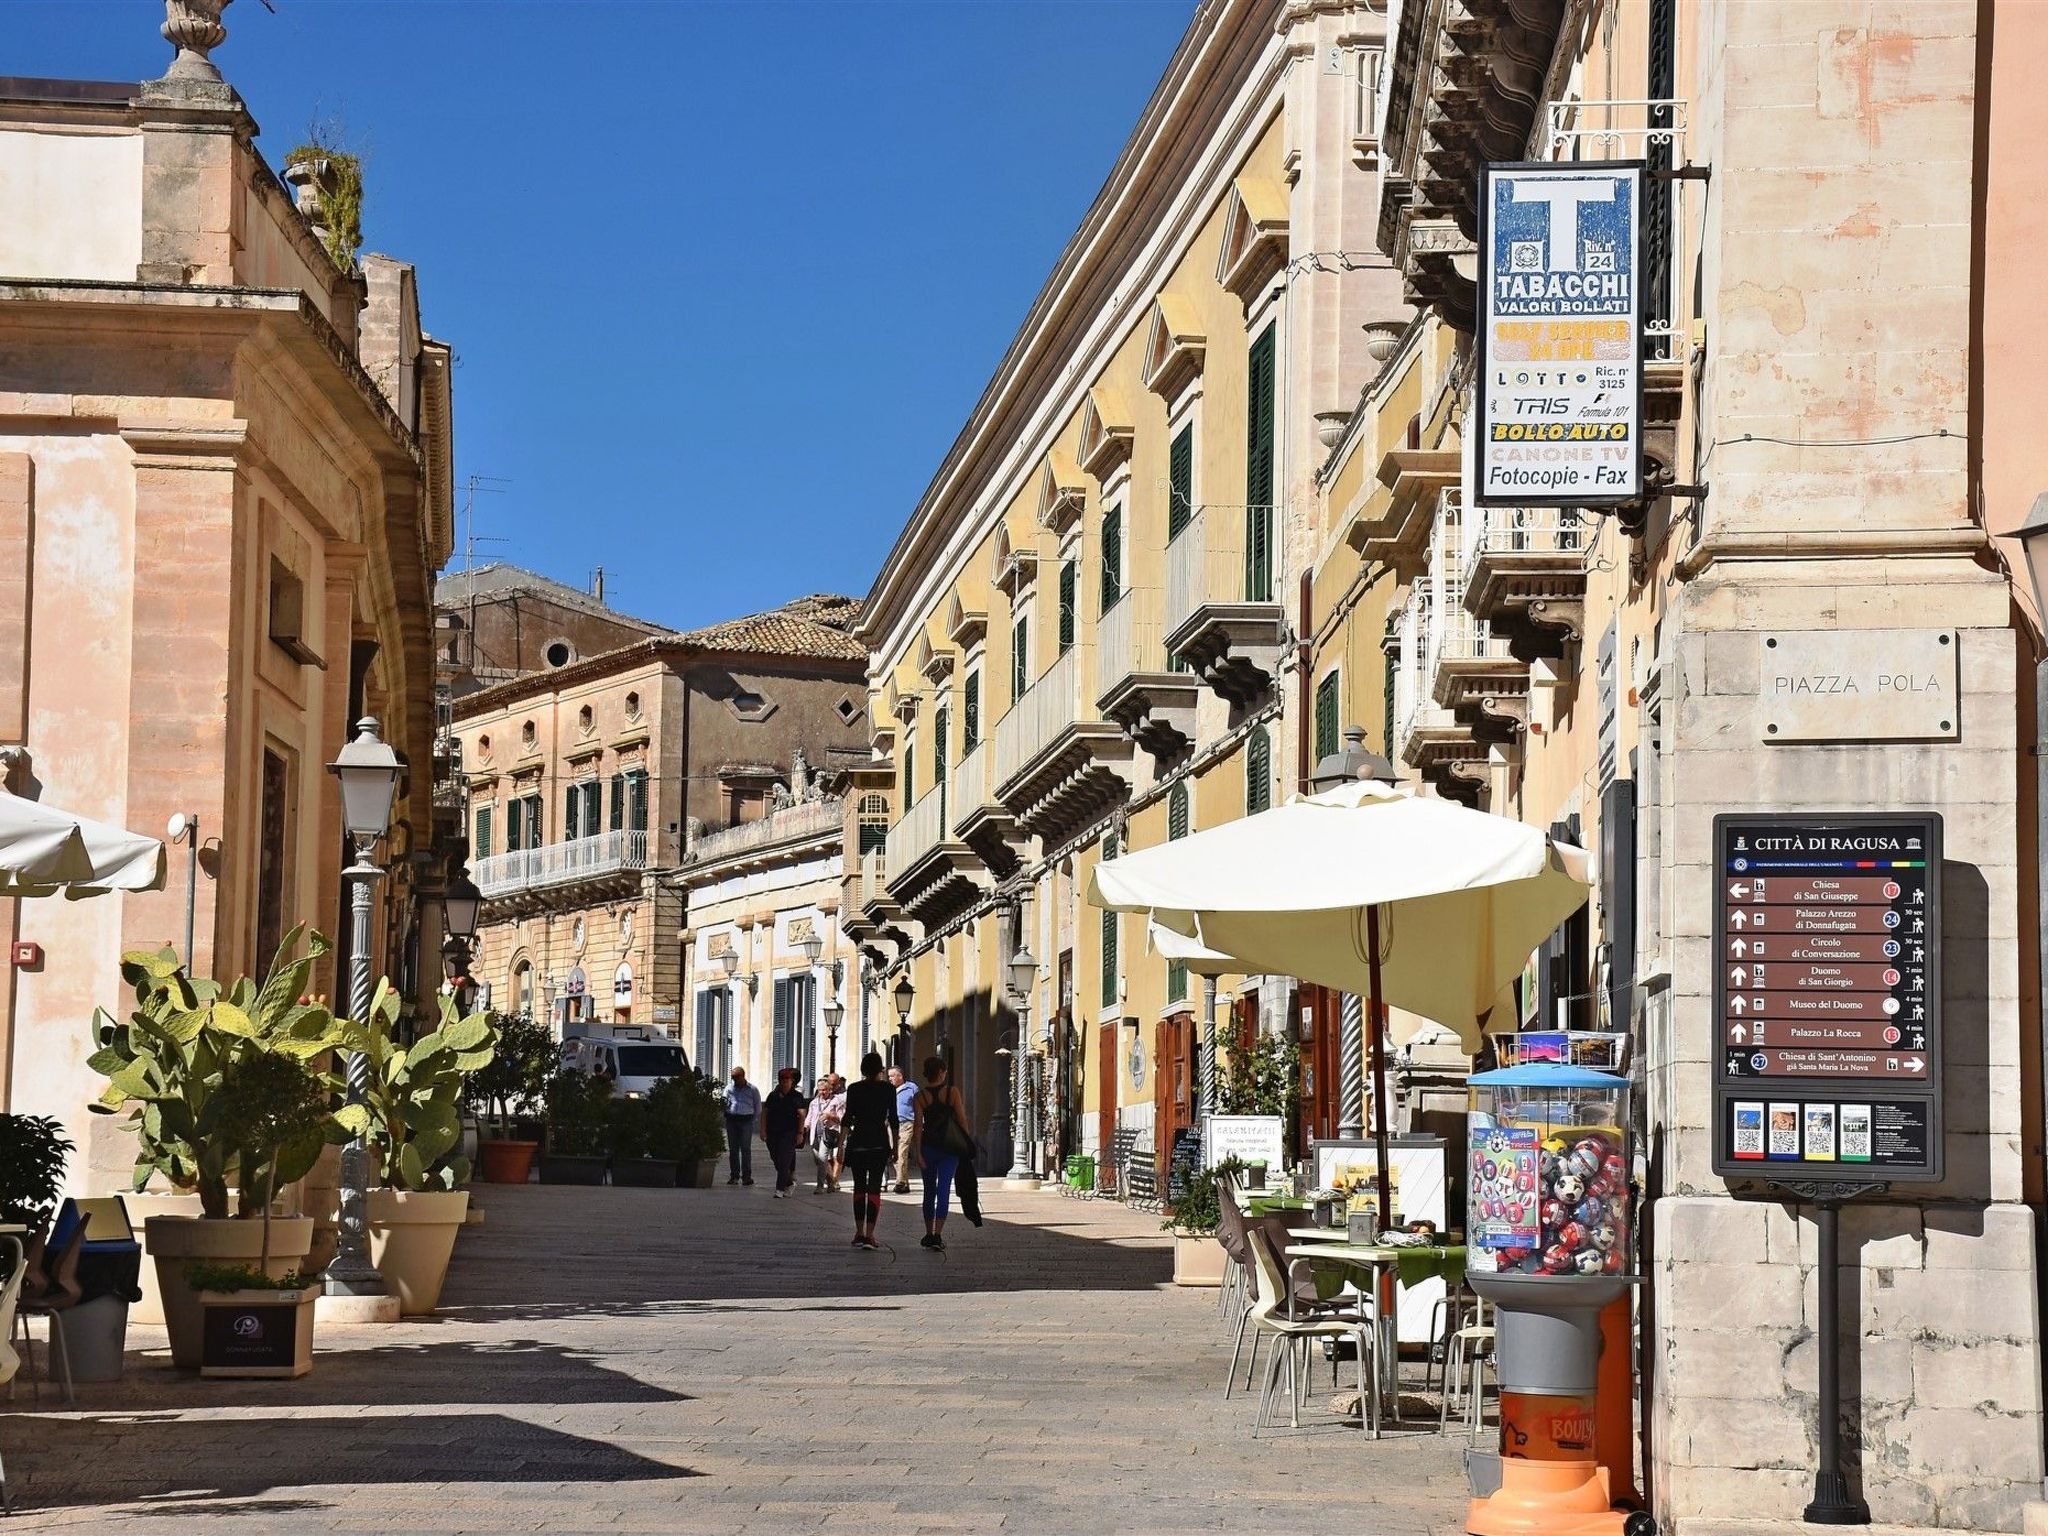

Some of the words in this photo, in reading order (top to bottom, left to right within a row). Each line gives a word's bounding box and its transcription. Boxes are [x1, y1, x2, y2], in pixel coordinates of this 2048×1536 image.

[1512, 179, 1616, 272] T
[1589, 255, 1612, 268] 24
[1497, 274, 1629, 298] TABACCHI
[1498, 301, 1556, 313] VALORI
[1561, 300, 1628, 312] BOLLATI
[1595, 366, 1616, 377] Ric.
[1498, 372, 1587, 386] LOTTO
[1599, 379, 1626, 389] 3125
[1514, 397, 1570, 414] TRIS
[1577, 406, 1612, 418] Formula
[1612, 405, 1630, 417] 101
[1494, 424, 1564, 440] BOLLO
[1567, 423, 1627, 440] AUTO
[1491, 447, 1593, 461] CANONE
[1601, 447, 1629, 460] TV
[1490, 466, 1579, 489] Fotocopie
[1595, 465, 1628, 484] Fax
[1775, 676, 1860, 694] PIAZZA
[1878, 674, 1941, 692] POLA
[1755, 835, 1804, 850] CITTÀ
[1809, 838, 1826, 850] DI
[1831, 837, 1900, 850] RAGUSA
[1812, 881, 1839, 889] Chiesa
[1794, 892, 1802, 900] di
[1804, 892, 1819, 900] San
[1820, 892, 1858, 902] Giuseppe
[1796, 909, 1826, 918] Palazzo
[1828, 909, 1857, 918] Arezzo
[1886, 915, 1898, 924] 24
[1796, 921, 1803, 929] di
[1805, 921, 1856, 931] Donnafugata
[1811, 938, 1841, 947] Circolo
[1886, 944, 1897, 953] 23
[1792, 950, 1800, 958] di
[1801, 950, 1860, 958] Conversazione
[1811, 967, 1841, 975] Duomo
[1886, 973, 1897, 982] 14
[1808, 978, 1822, 986] San
[1824, 978, 1853, 988] Giorgio
[1790, 1001, 1817, 1009] Museo
[1819, 1001, 1830, 1009] del
[1833, 1001, 1863, 1009] Duomo
[1791, 1029, 1821, 1038] Palazzo
[1823, 1029, 1834, 1037] La
[1836, 1029, 1861, 1038] Rocca
[1753, 1057, 1765, 1066] 27
[1779, 1052, 1806, 1061] Chiesa
[1808, 1052, 1816, 1061] di
[1818, 1053, 1876, 1062] Sant'Antonino
